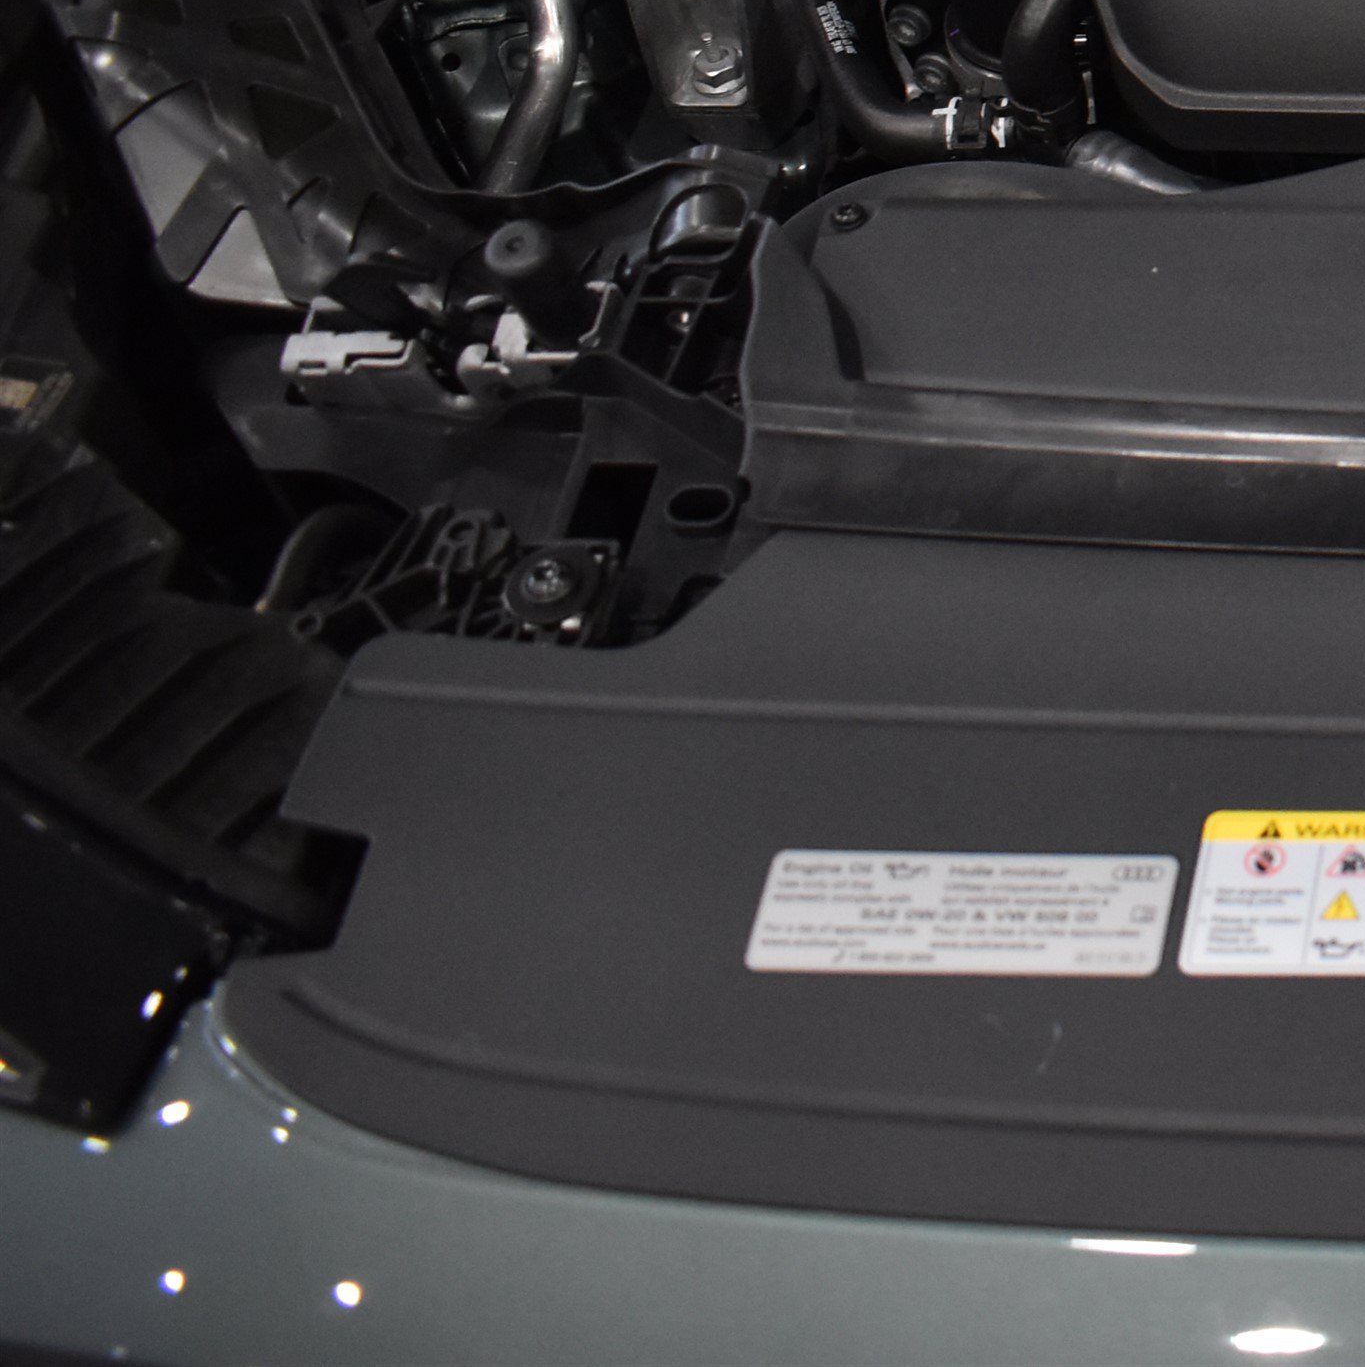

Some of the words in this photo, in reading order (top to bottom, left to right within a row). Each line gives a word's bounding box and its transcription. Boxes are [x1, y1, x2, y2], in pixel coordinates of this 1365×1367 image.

[782, 860, 843, 877] Engine
[849, 861, 874, 874] Oil
[860, 907, 898, 921] SAE
